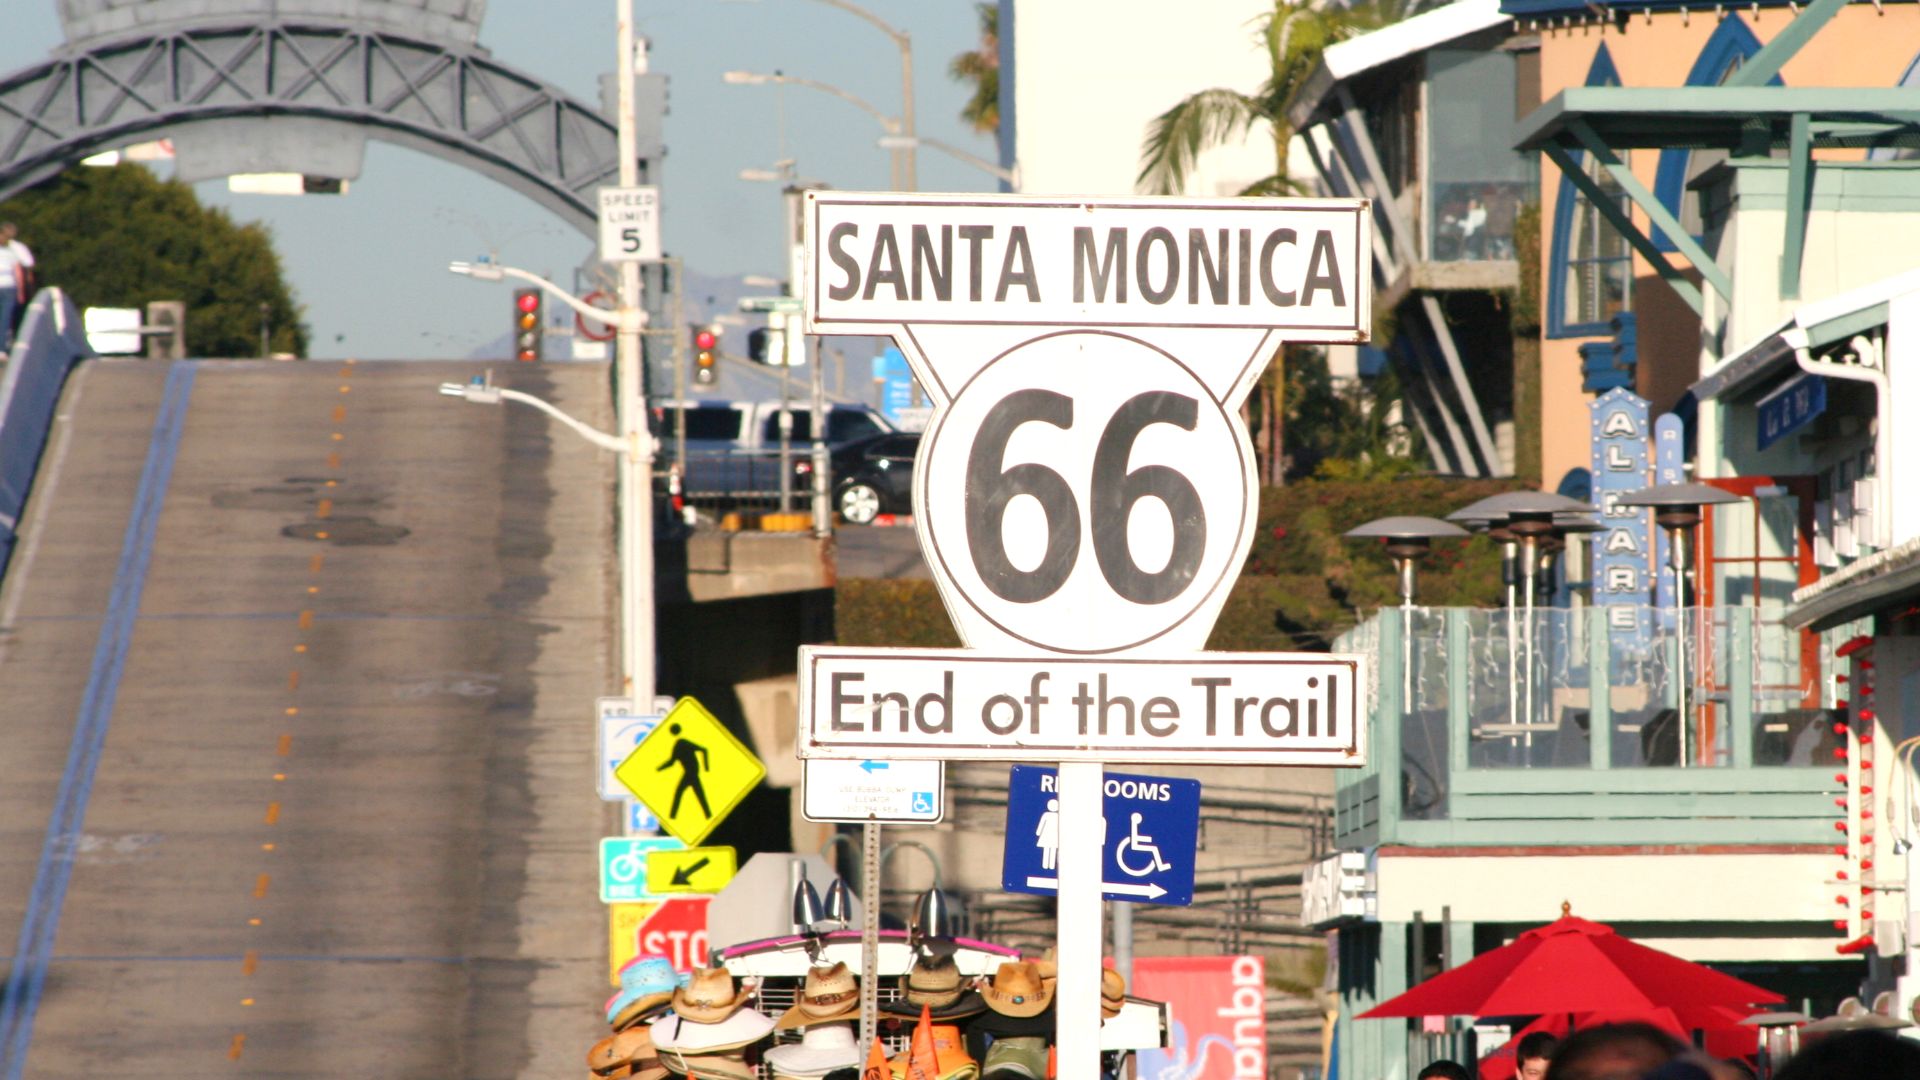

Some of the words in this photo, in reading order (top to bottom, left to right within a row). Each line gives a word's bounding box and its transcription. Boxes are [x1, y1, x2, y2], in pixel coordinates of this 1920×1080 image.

[604, 194, 653, 206] SPEED
[608, 210, 649, 223] LIMIT
[622, 227, 641, 253] 5
[829, 223, 1040, 302] SANTA
[1074, 227, 1345, 306] MONICA
[966, 389, 1206, 604] 66
[832, 671, 953, 733] End
[981, 672, 1050, 735] of
[1072, 674, 1180, 737] the
[1192, 675, 1337, 737] Trail
